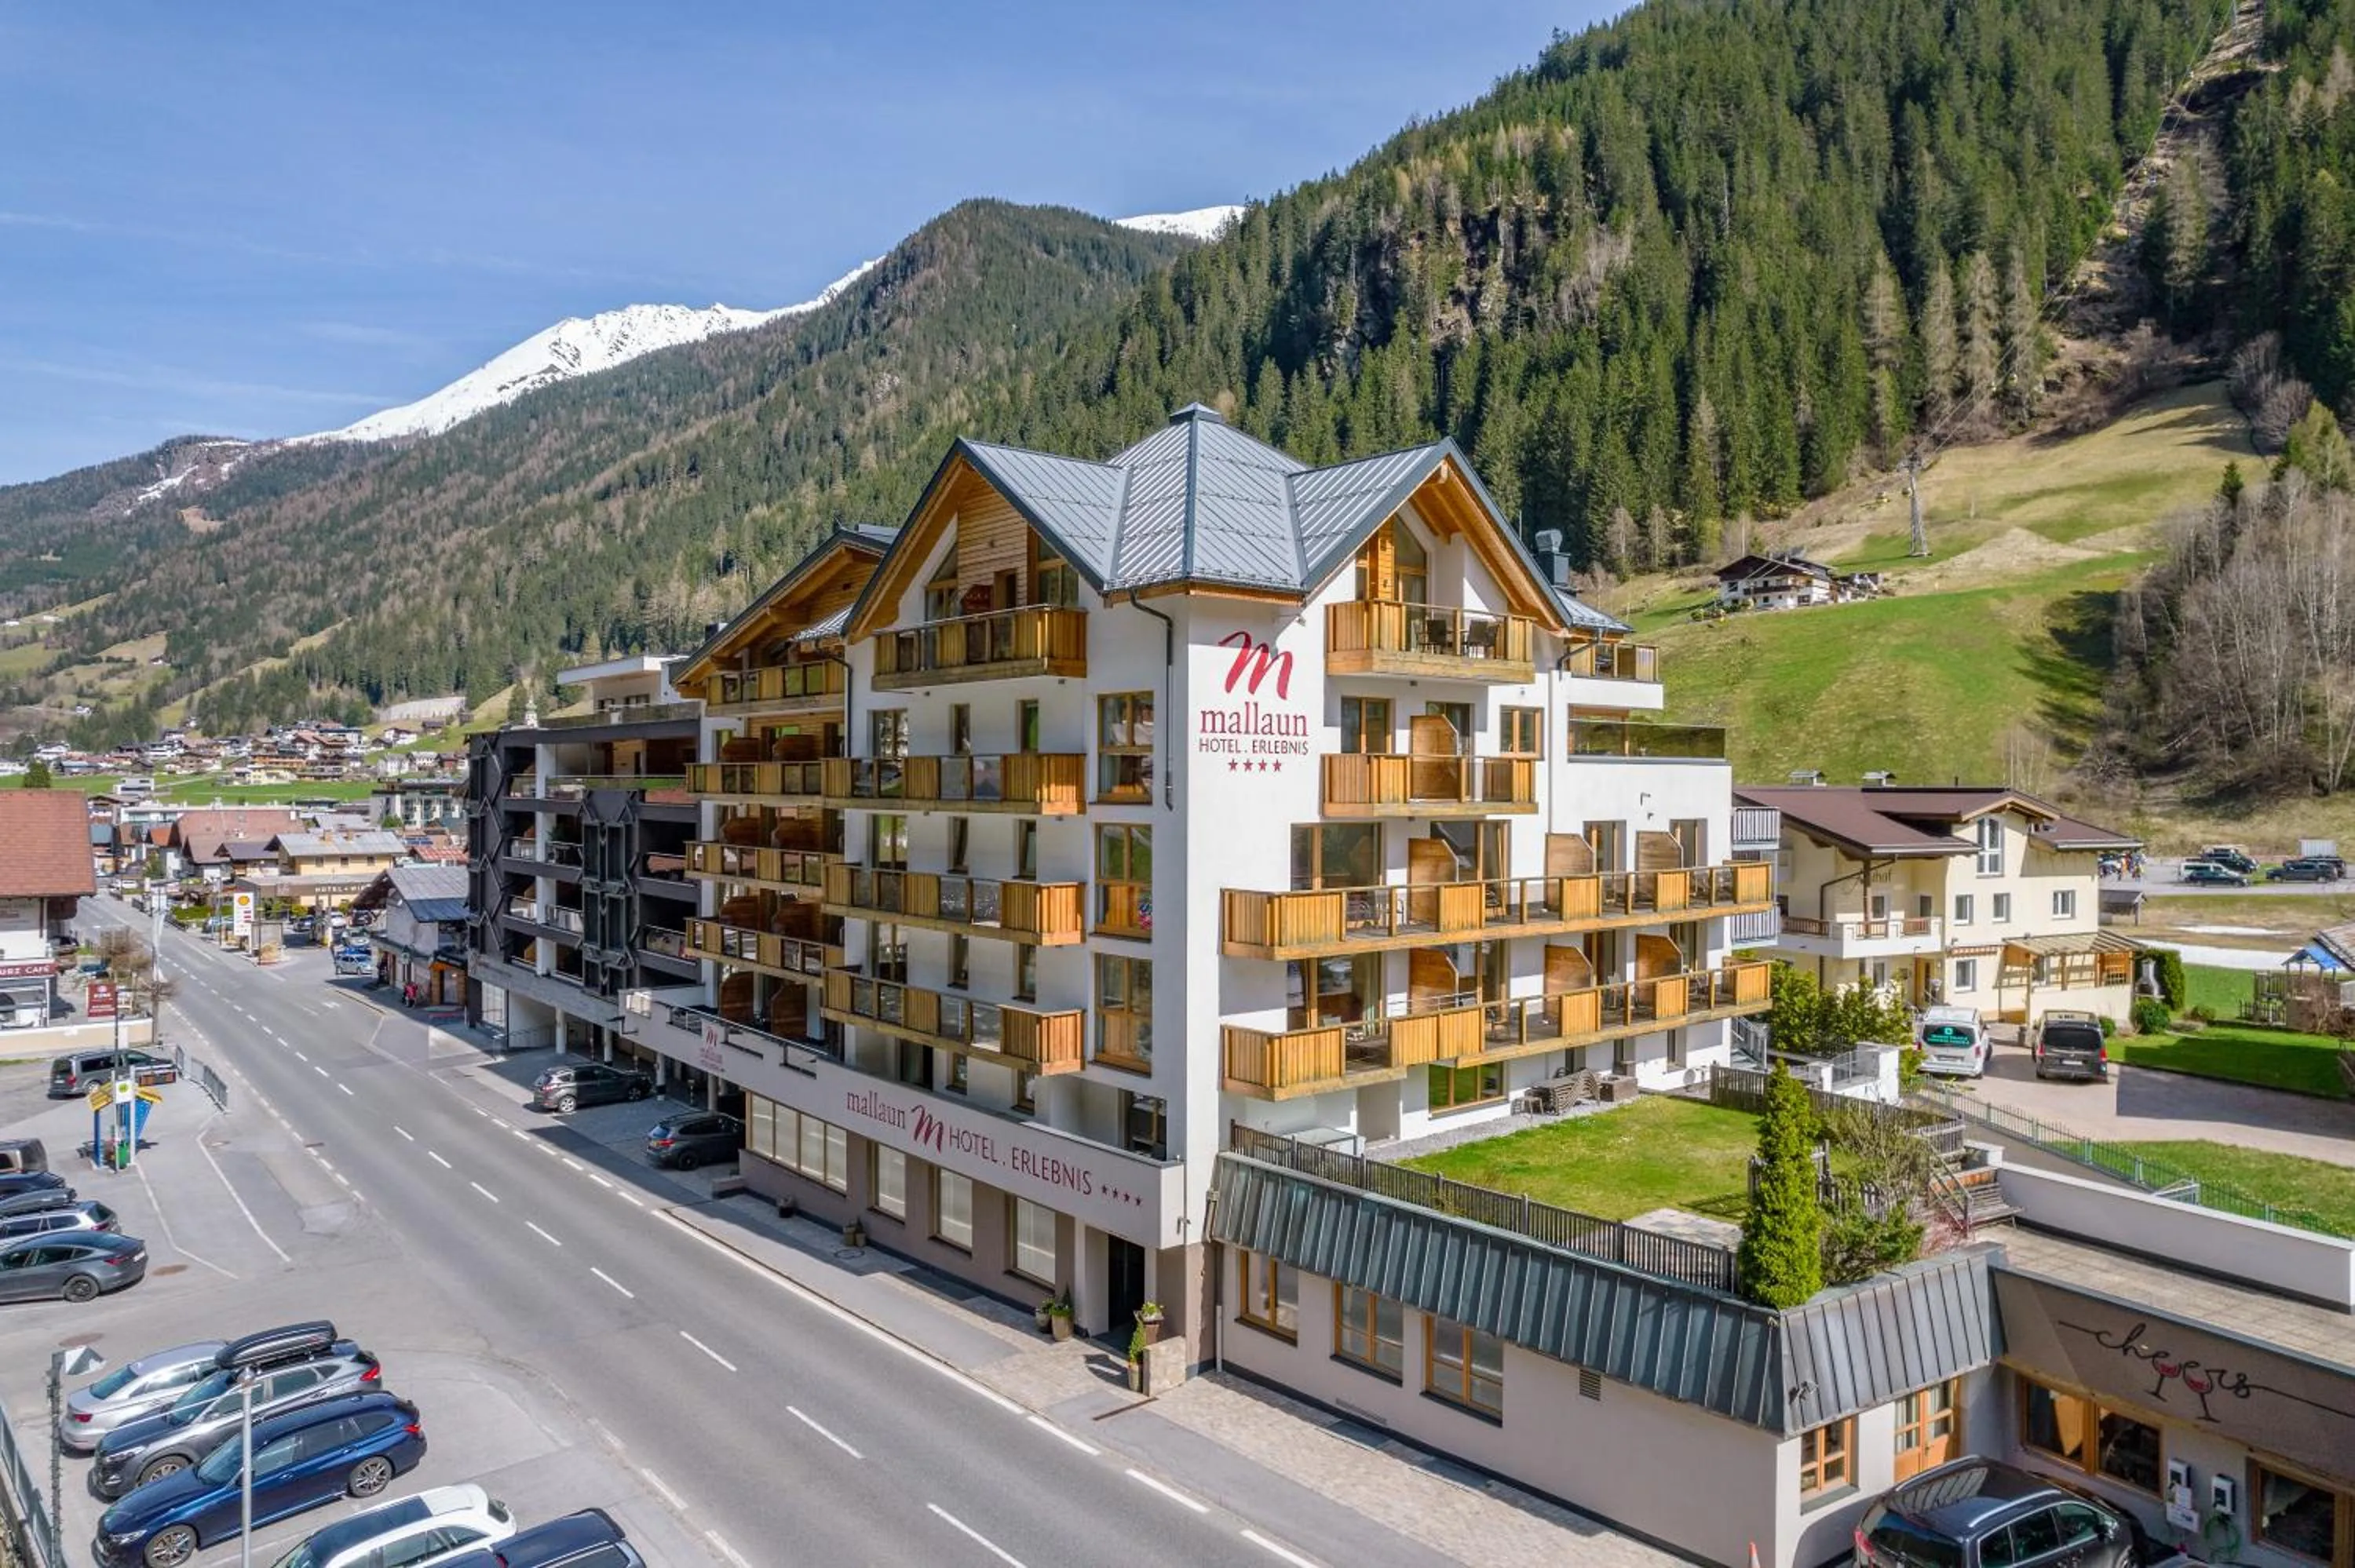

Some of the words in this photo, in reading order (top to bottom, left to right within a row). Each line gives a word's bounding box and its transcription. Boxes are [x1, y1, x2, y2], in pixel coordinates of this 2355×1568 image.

[1199, 701, 1310, 737] mallaun
[1251, 739, 1309, 756] ERLEBNIS
[846, 1091, 907, 1129] mallaun
[1011, 1146, 1093, 1197] ERLEBNIS
